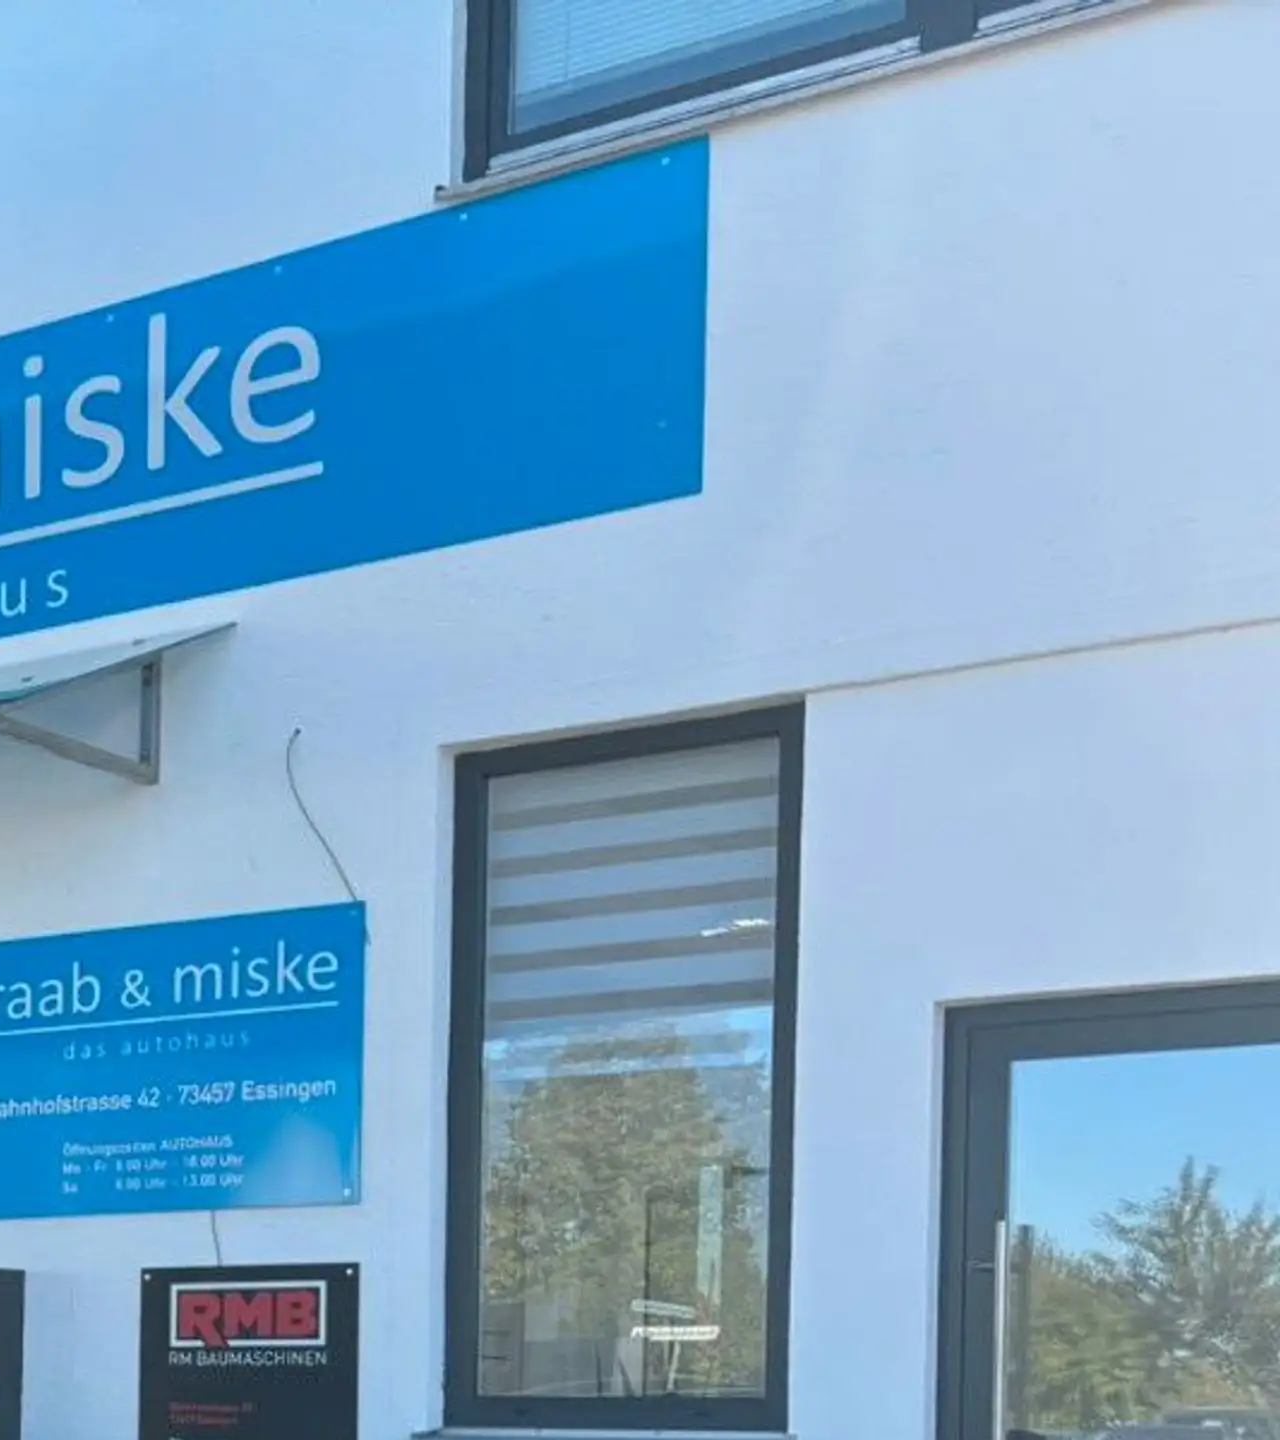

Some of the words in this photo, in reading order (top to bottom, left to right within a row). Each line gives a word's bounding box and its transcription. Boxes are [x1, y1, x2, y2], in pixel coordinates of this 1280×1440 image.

[120, 968, 152, 1009] &
[173, 940, 339, 1004] miske
[62, 1041, 108, 1060] das
[119, 1030, 251, 1057] autohaus
[177, 1080, 236, 1106] 73457
[241, 1079, 337, 1104] Essingen
[179, 1290, 317, 1348] RMB
[168, 1350, 192, 1366] RM
[196, 1349, 328, 1367] BAUMASCHINEN
